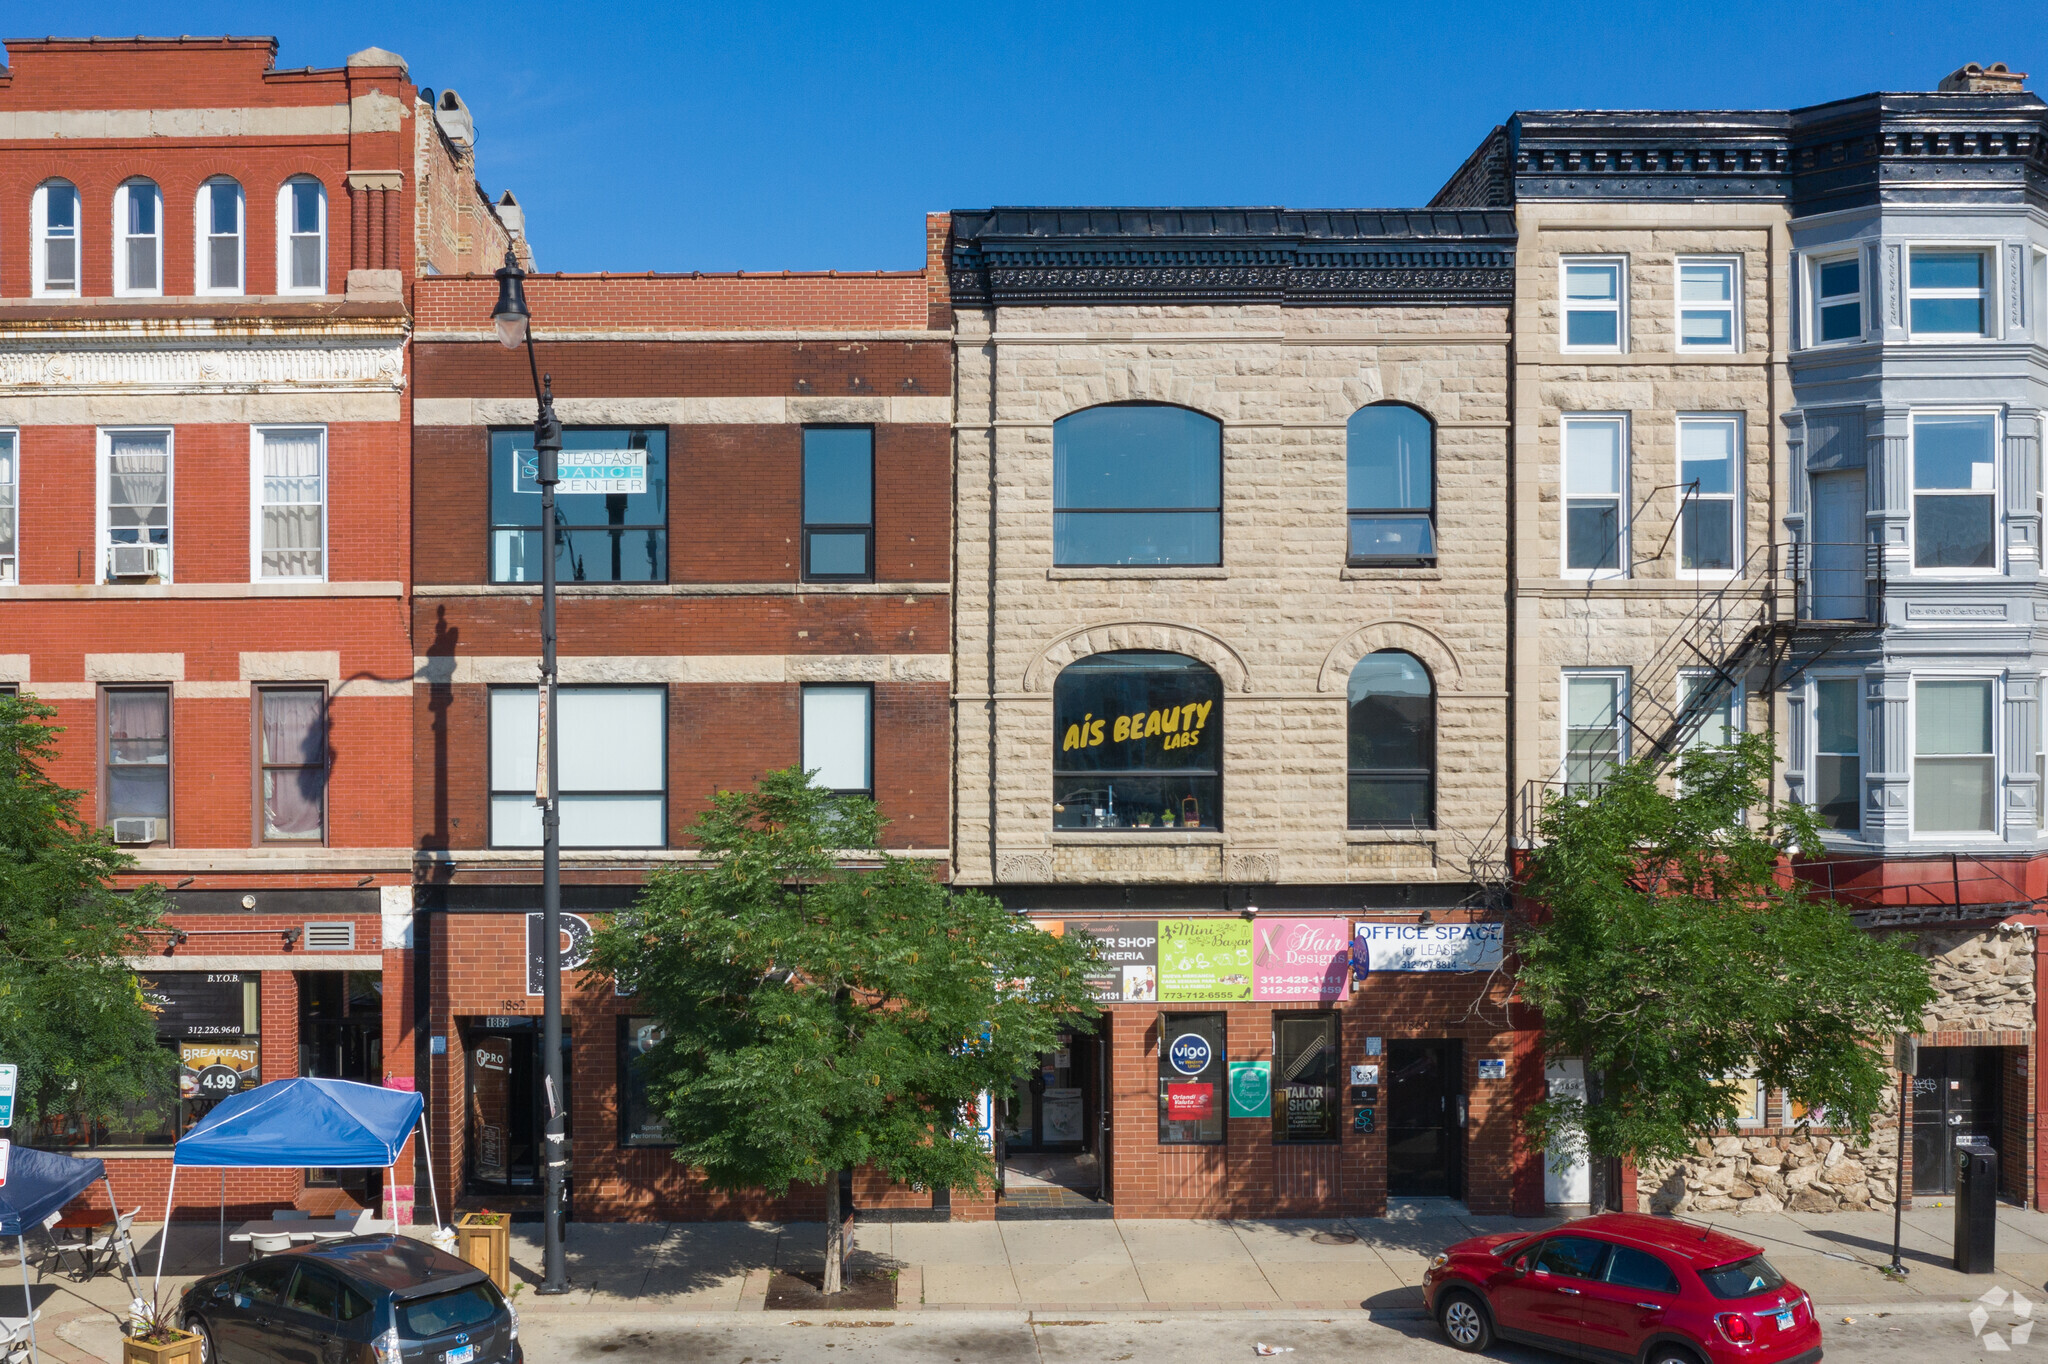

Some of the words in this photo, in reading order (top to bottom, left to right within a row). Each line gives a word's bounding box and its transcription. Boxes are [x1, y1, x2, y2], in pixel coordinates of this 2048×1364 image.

[558, 452, 640, 465] STEADFAST
[558, 467, 642, 478] DANCE
[555, 479, 642, 492] CENTER
[1113, 700, 1213, 743] BEAUTY
[1163, 730, 1200, 750] LABS
[1173, 922, 1214, 936] Mini
[1358, 926, 1429, 940] OFFICE
[1435, 926, 1503, 940] SPACE
[1118, 937, 1156, 948] SHOP
[1211, 936, 1251, 949] Bazar
[1287, 924, 1346, 951] Hair
[1402, 943, 1417, 956] for
[1421, 943, 1458, 956] LEASE
[1286, 950, 1346, 966] Designs
[1401, 960, 1457, 969] 312-767-8814
[207, 974, 240, 983] B.Y.O.B.
[1260, 976, 1341, 984] 312-428-1111
[1260, 986, 1342, 994] 312-287-9459
[501, 1000, 526, 1011] 1862
[486, 1018, 510, 1027] 1862
[188, 1026, 241, 1034] 312.226.9640
[183, 1048, 256, 1063] BREAKFAST
[1175, 1044, 1207, 1059] vigo
[202, 1074, 236, 1089] 4.99
[1287, 1086, 1324, 1099] TAILOR
[1289, 1099, 1320, 1111] SHOP
